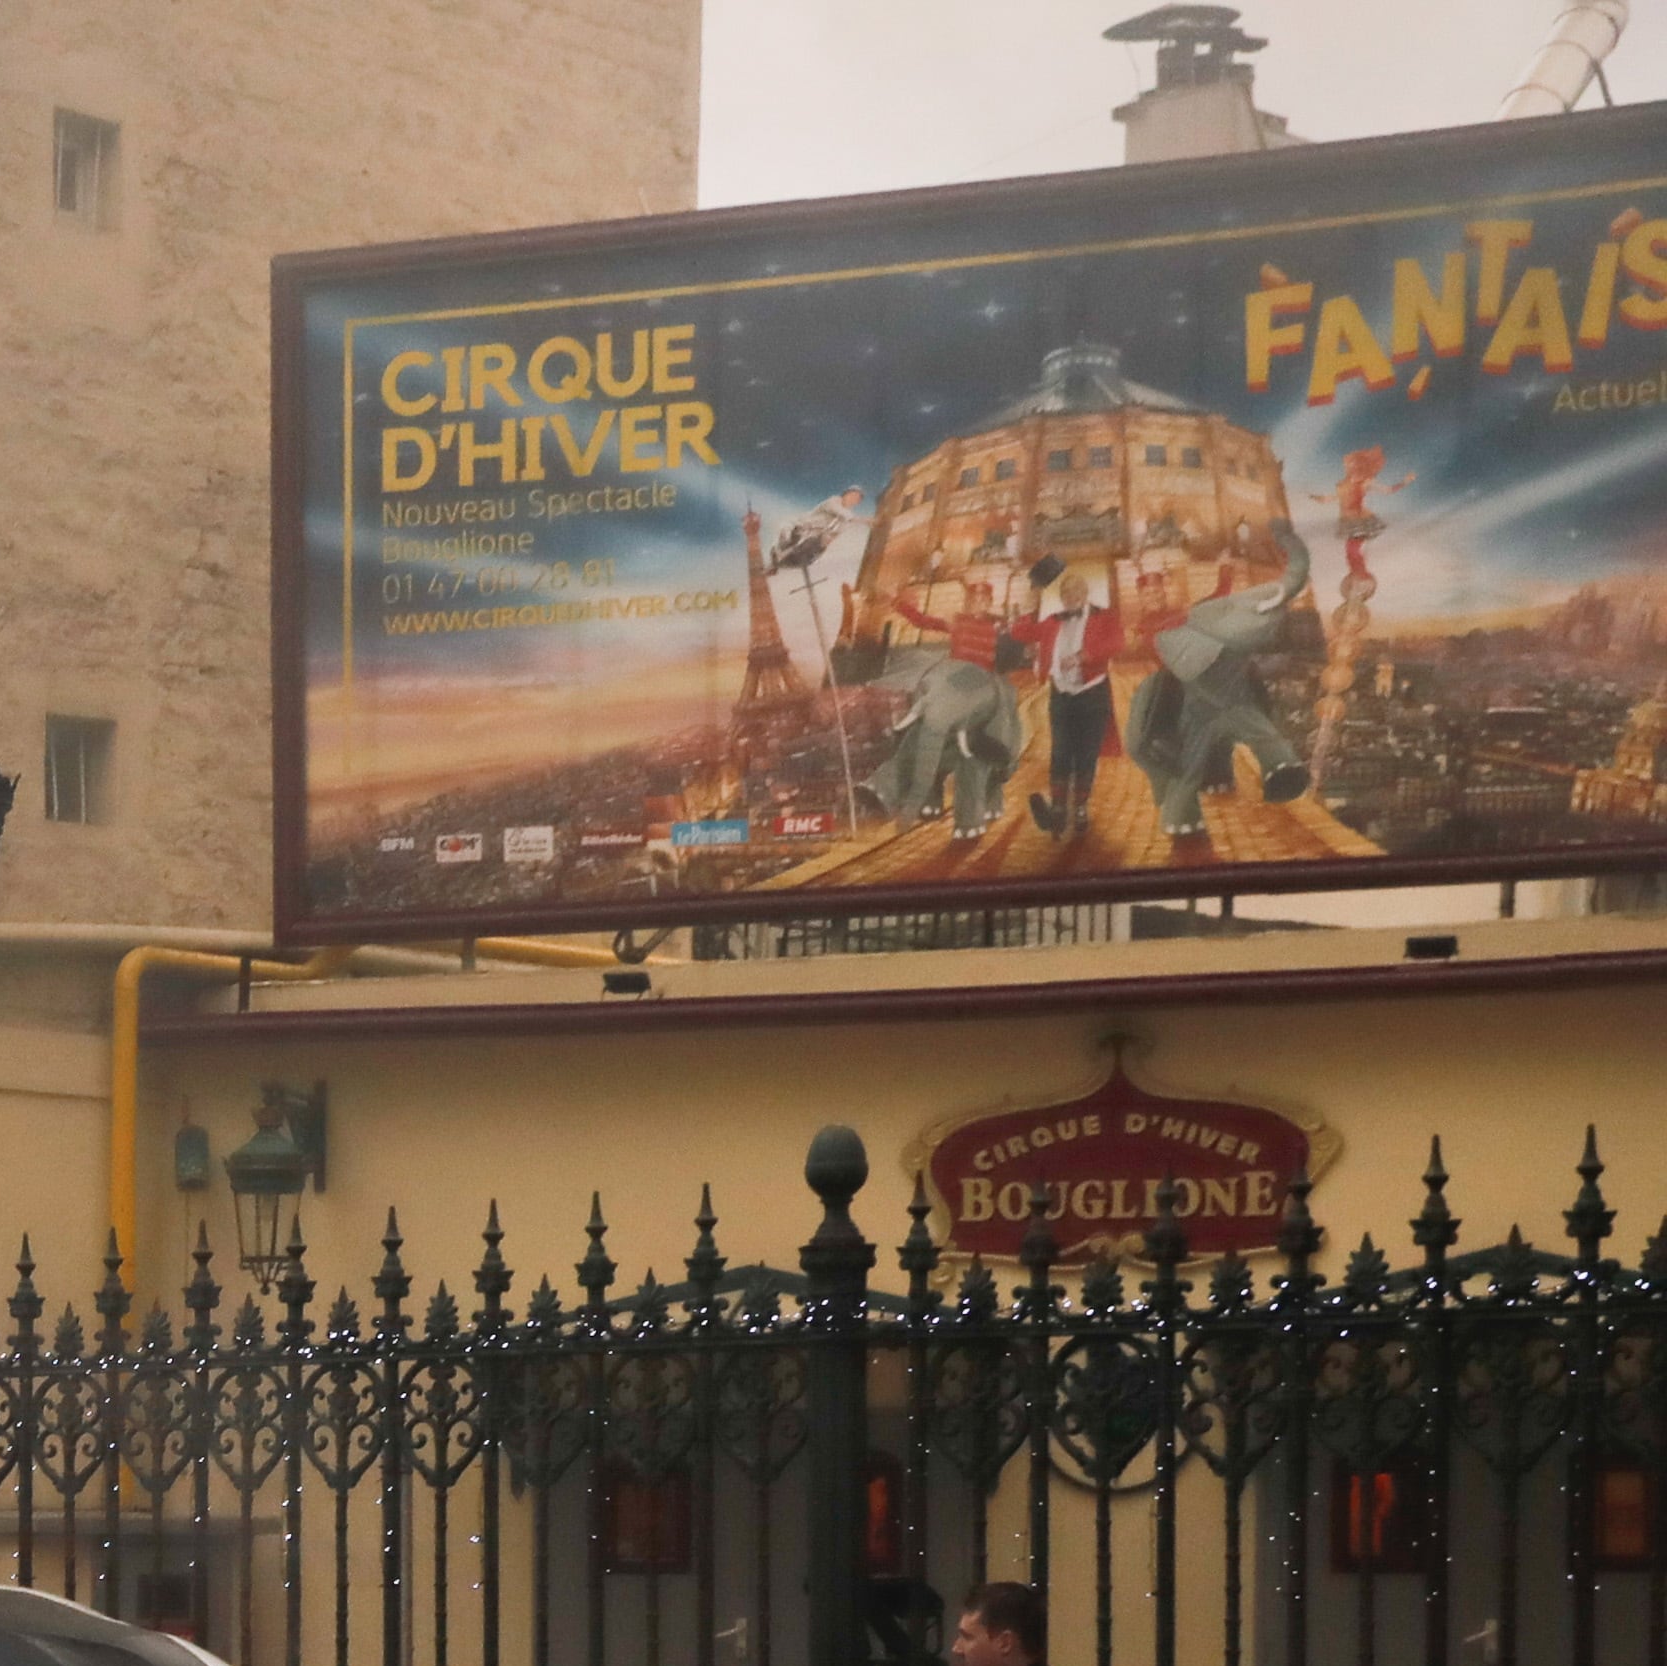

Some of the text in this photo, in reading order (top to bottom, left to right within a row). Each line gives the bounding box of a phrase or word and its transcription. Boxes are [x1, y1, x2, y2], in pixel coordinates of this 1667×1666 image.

[381, 323, 696, 417] CIRQUE
[381, 401, 721, 493] D'HIVER
[381, 481, 677, 528] Nouveau Spectacle
[382, 530, 535, 565] Bouglione
[381, 573, 414, 604] 01
[428, 571, 465, 599] 47
[782, 817, 822, 833] RMC
[973, 1113, 1262, 1171] CIRQUE D'HIVER
[958, 1170, 1279, 1222] BOUGLIONE
